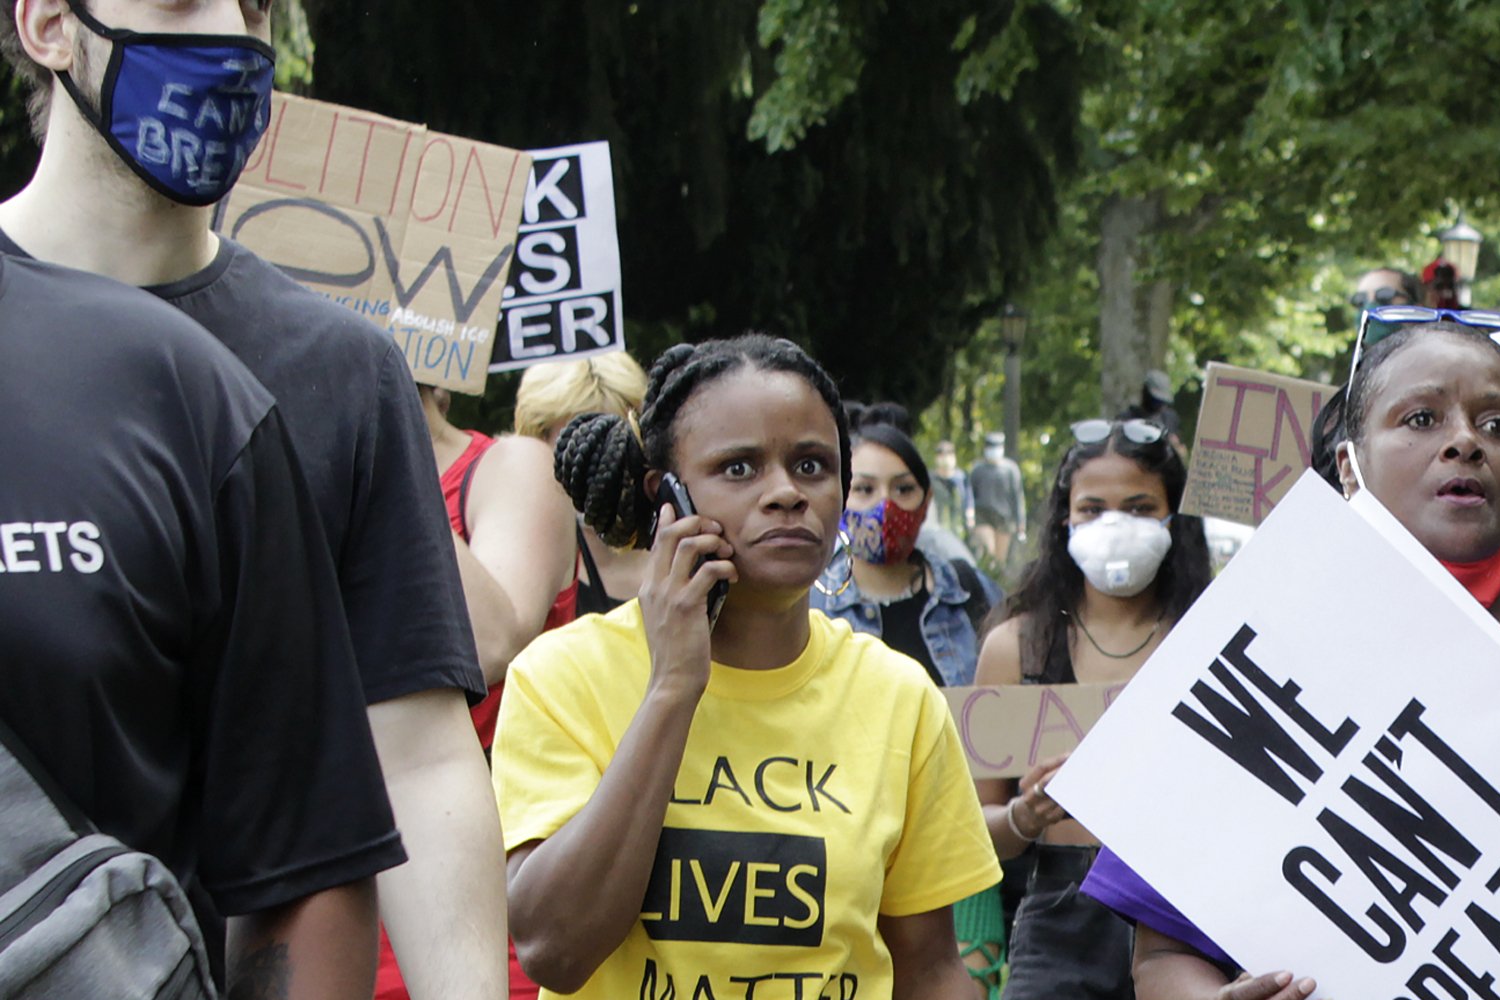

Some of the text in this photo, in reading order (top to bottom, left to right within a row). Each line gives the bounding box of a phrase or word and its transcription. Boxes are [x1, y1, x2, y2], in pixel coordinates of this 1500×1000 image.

[388, 325, 474, 380] TION
[390, 307, 490, 343] ABOLISH ICE
[0, 520, 104, 574] ETS
[961, 687, 1127, 770] CA
[1171, 623, 1360, 806] WE
[669, 756, 853, 815] LACK
[640, 858, 821, 929] IVES
